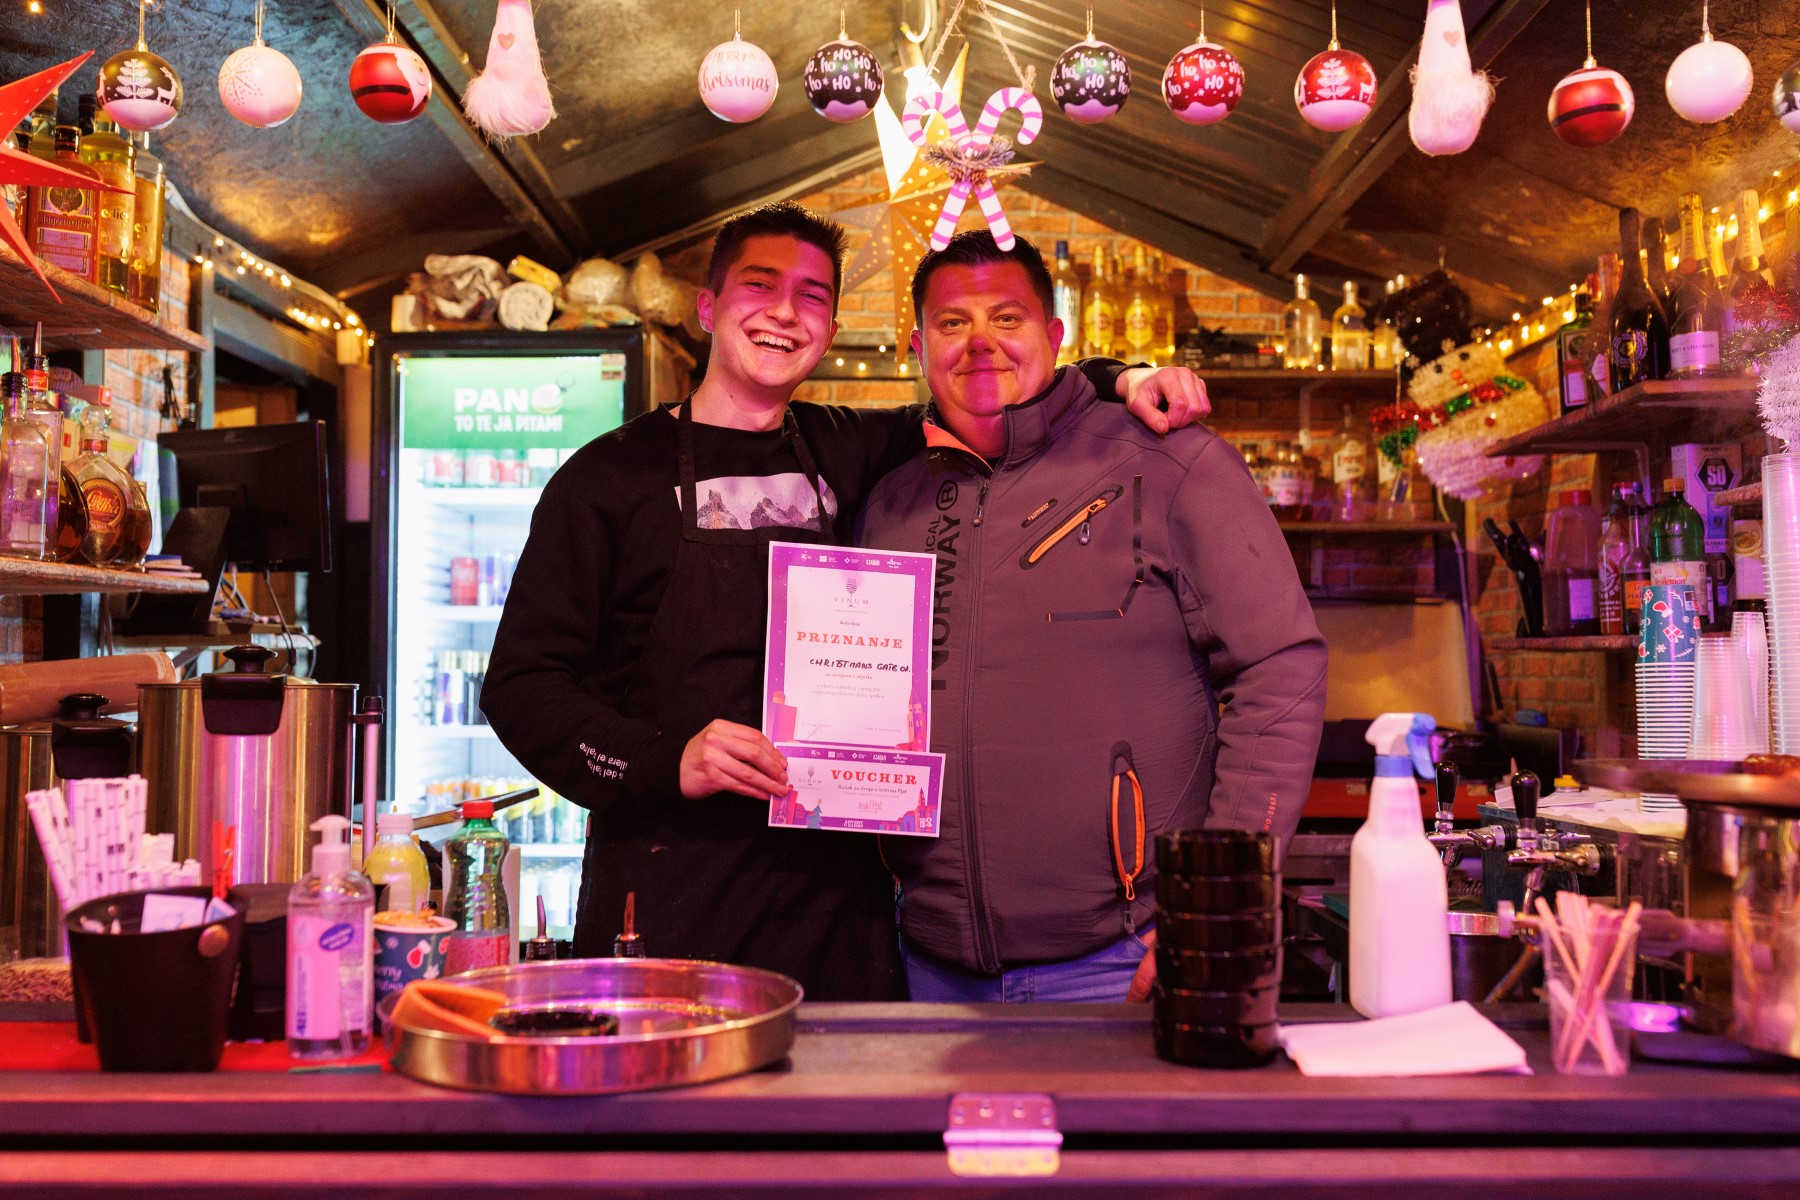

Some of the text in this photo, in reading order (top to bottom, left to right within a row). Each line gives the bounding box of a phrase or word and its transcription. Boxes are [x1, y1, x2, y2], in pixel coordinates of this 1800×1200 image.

[455, 415, 563, 432] TO TE JA PITAM!
[833, 596, 869, 604] VINUM
[797, 631, 903, 649] PRIZNANJE
[831, 769, 917, 785] VOUCHER
